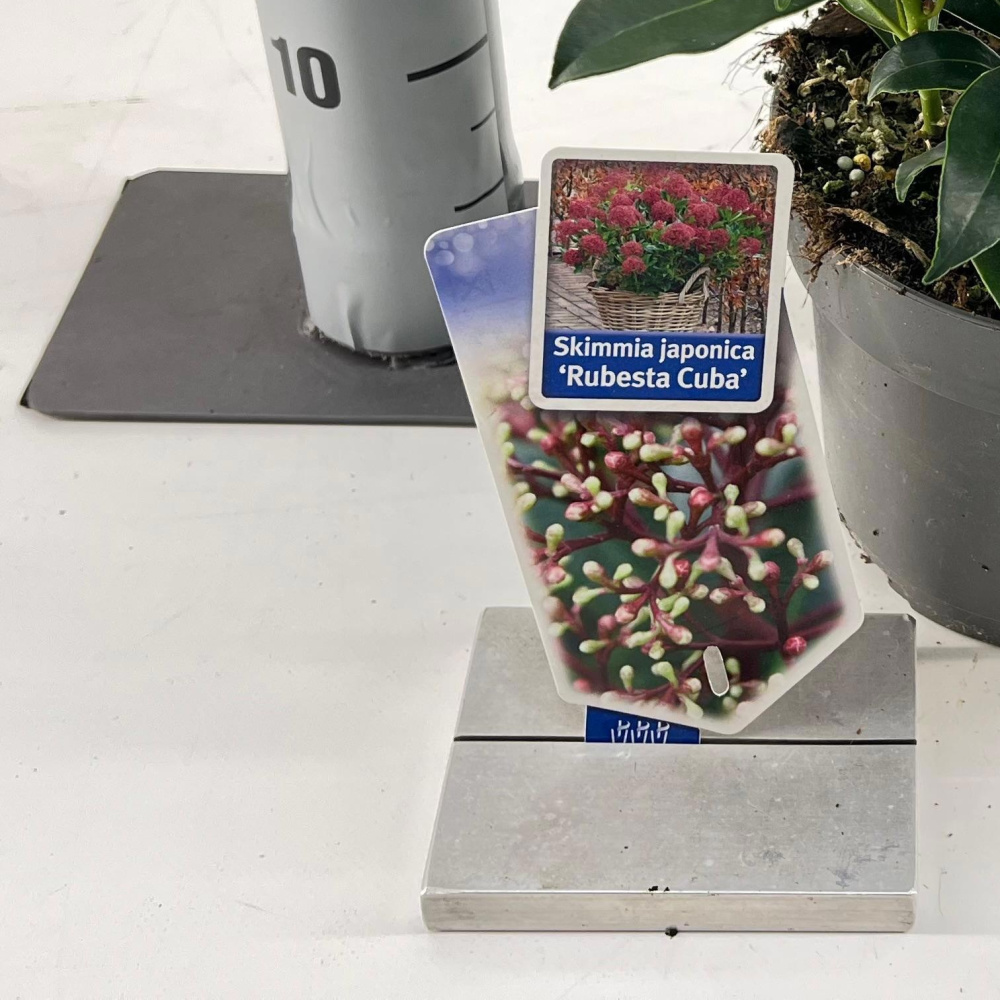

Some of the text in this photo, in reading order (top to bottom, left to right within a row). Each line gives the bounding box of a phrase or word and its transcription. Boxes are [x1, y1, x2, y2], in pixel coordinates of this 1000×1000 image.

[271, 36, 341, 109] 10
[553, 336, 755, 363] Skimmia japonica
